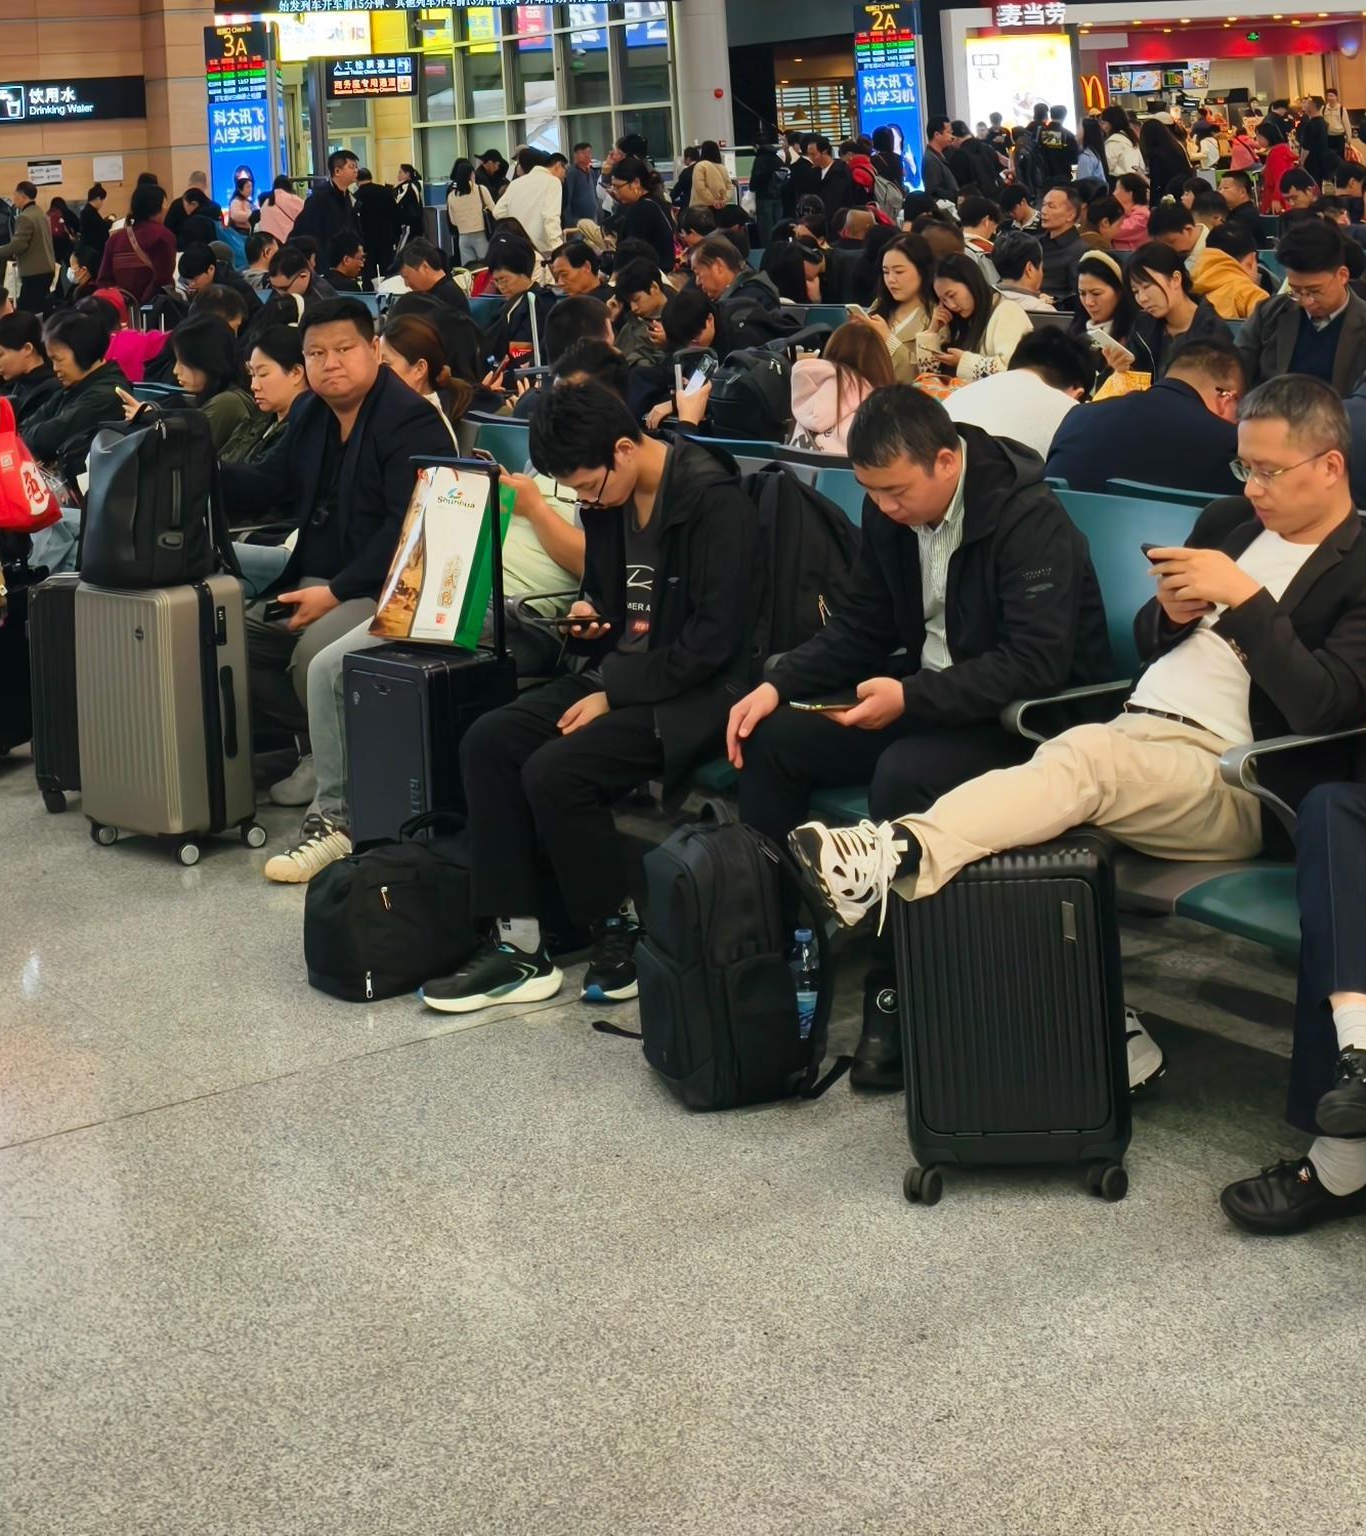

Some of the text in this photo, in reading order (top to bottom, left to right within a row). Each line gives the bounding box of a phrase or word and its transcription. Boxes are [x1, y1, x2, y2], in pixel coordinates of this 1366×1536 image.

[872, 11, 897, 31] 2A
[996, 2, 1067, 27] 麦当劳
[223, 34, 248, 57] 3A
[863, 73, 914, 90] 科大讯飞
[29, 86, 76, 104] 饮用水
[863, 89, 915, 105] AI学习机
[29, 104, 94, 117] Drinking Water
[213, 107, 265, 126] 科大讯飞
[214, 125, 266, 145] AI学习机
